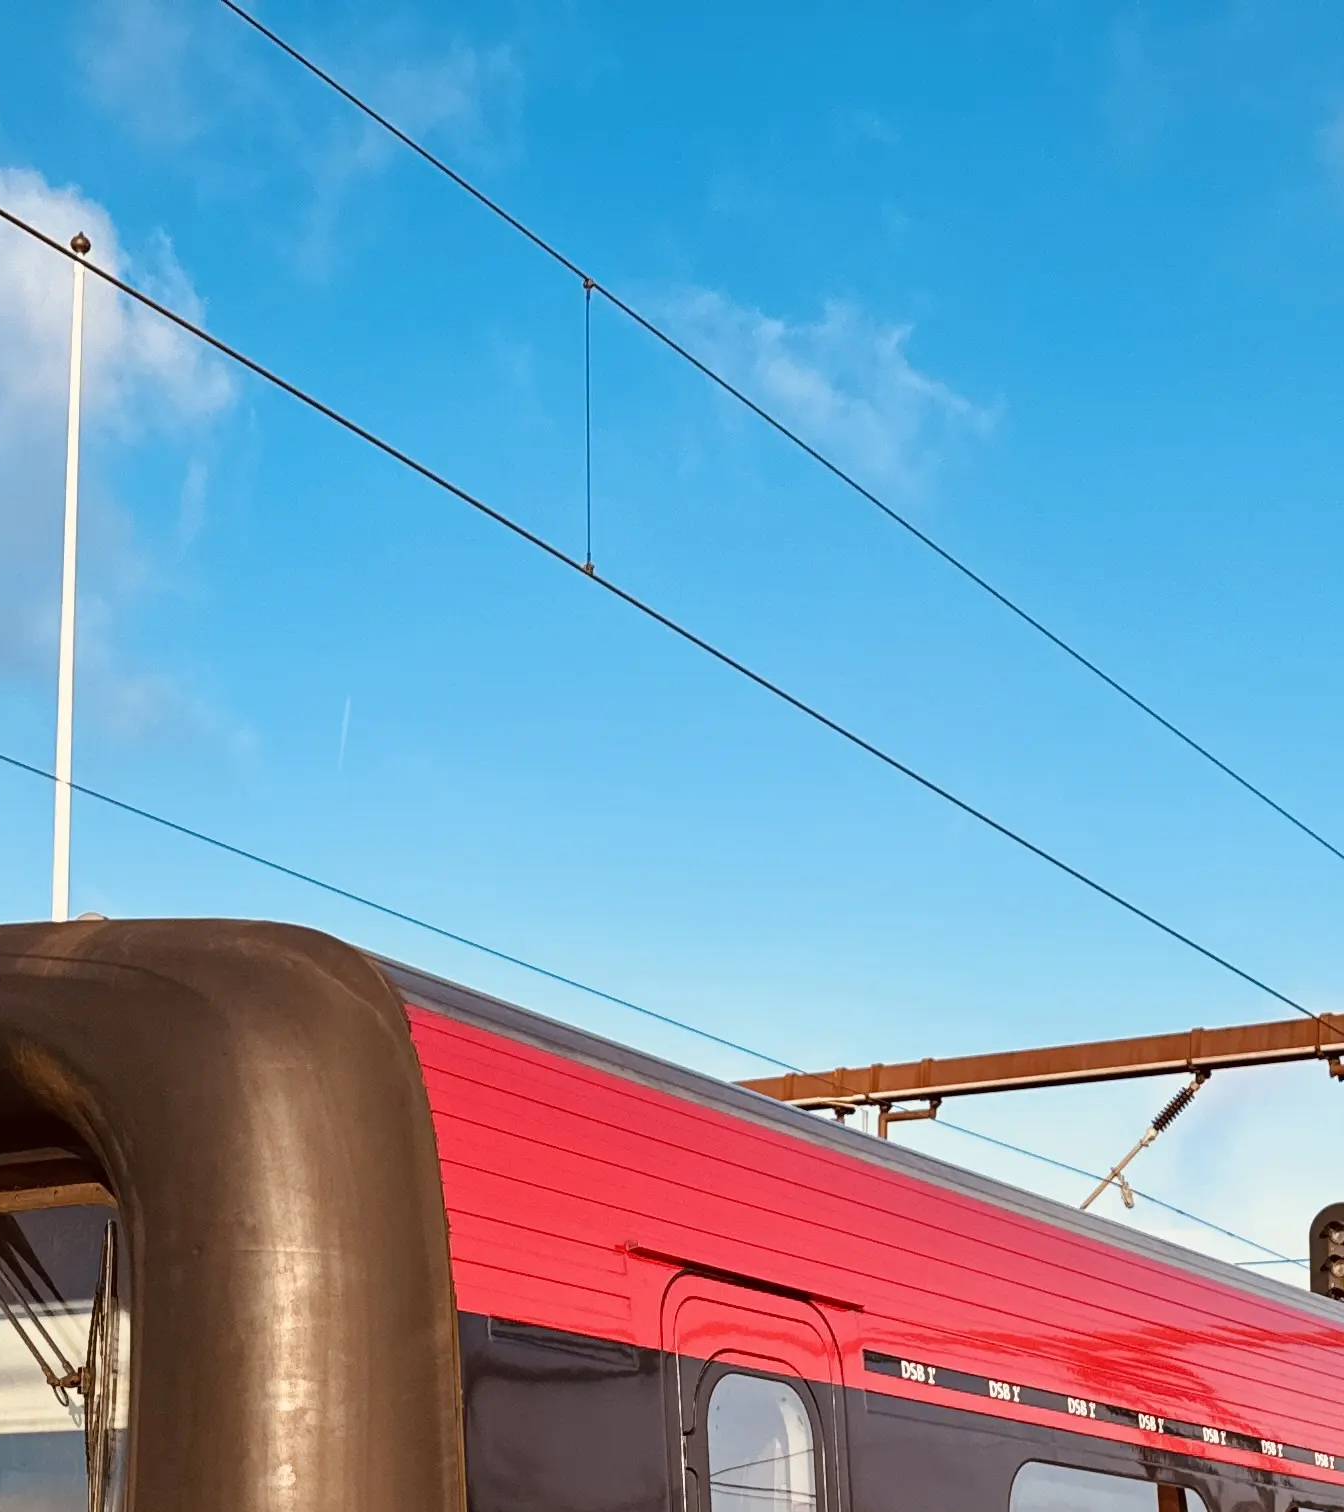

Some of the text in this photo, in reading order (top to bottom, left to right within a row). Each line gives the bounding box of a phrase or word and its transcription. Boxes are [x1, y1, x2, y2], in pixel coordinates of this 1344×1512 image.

[900, 1360, 925, 1382] DSB
[988, 1380, 1011, 1401] DSB
[1067, 1397, 1087, 1417] DSB
[1138, 1413, 1156, 1432] DSB
[1202, 1426, 1219, 1444] DSB
[1261, 1439, 1277, 1457] DSB
